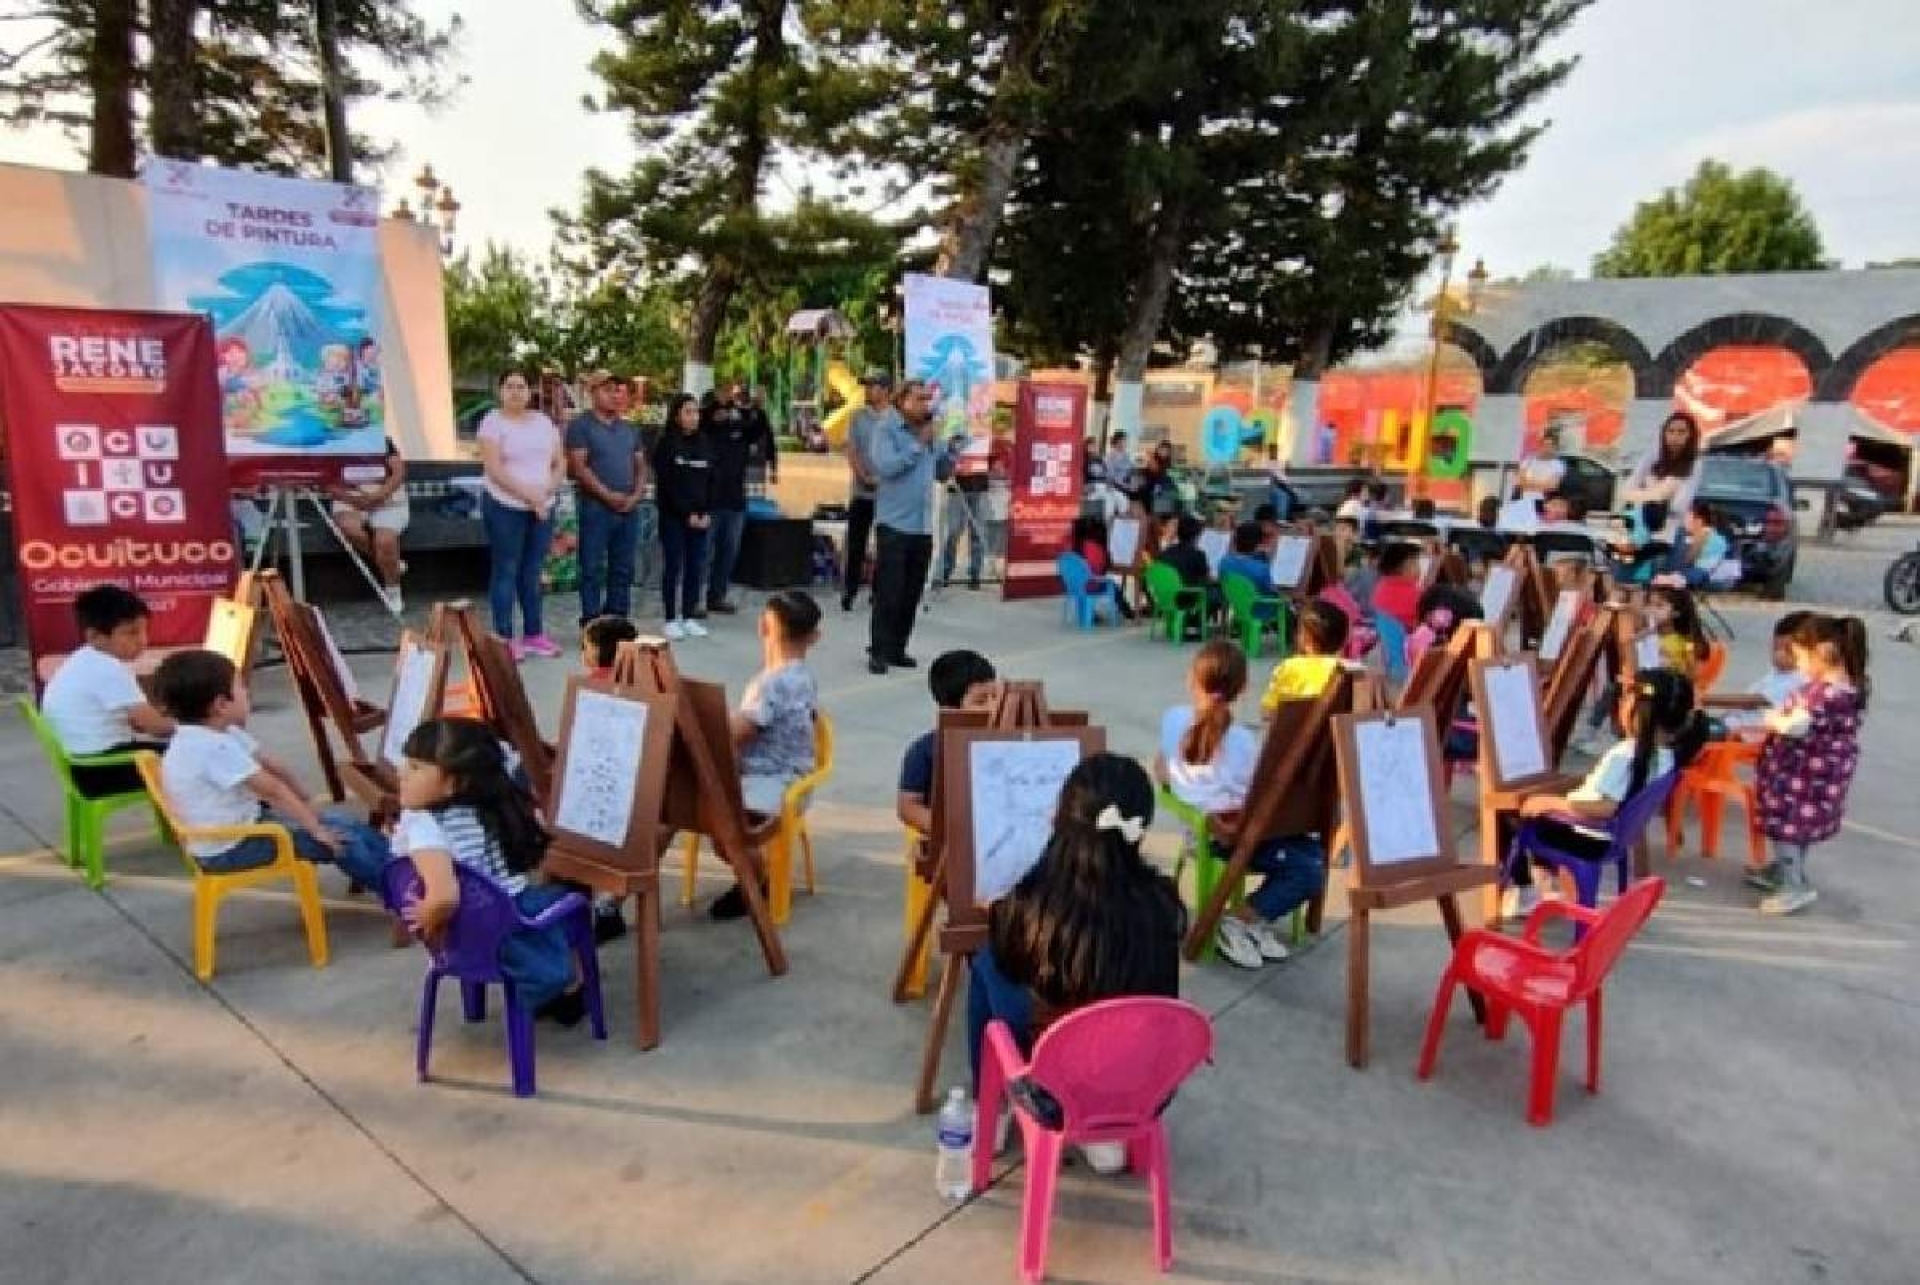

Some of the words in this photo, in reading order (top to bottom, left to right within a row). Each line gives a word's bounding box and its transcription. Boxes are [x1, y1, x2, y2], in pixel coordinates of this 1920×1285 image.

[226, 202, 314, 228] TARDES
[205, 219, 236, 238] DE
[241, 224, 338, 251] PINTURA
[50, 335, 164, 365] RENE
[20, 538, 235, 570] Ocuituco
